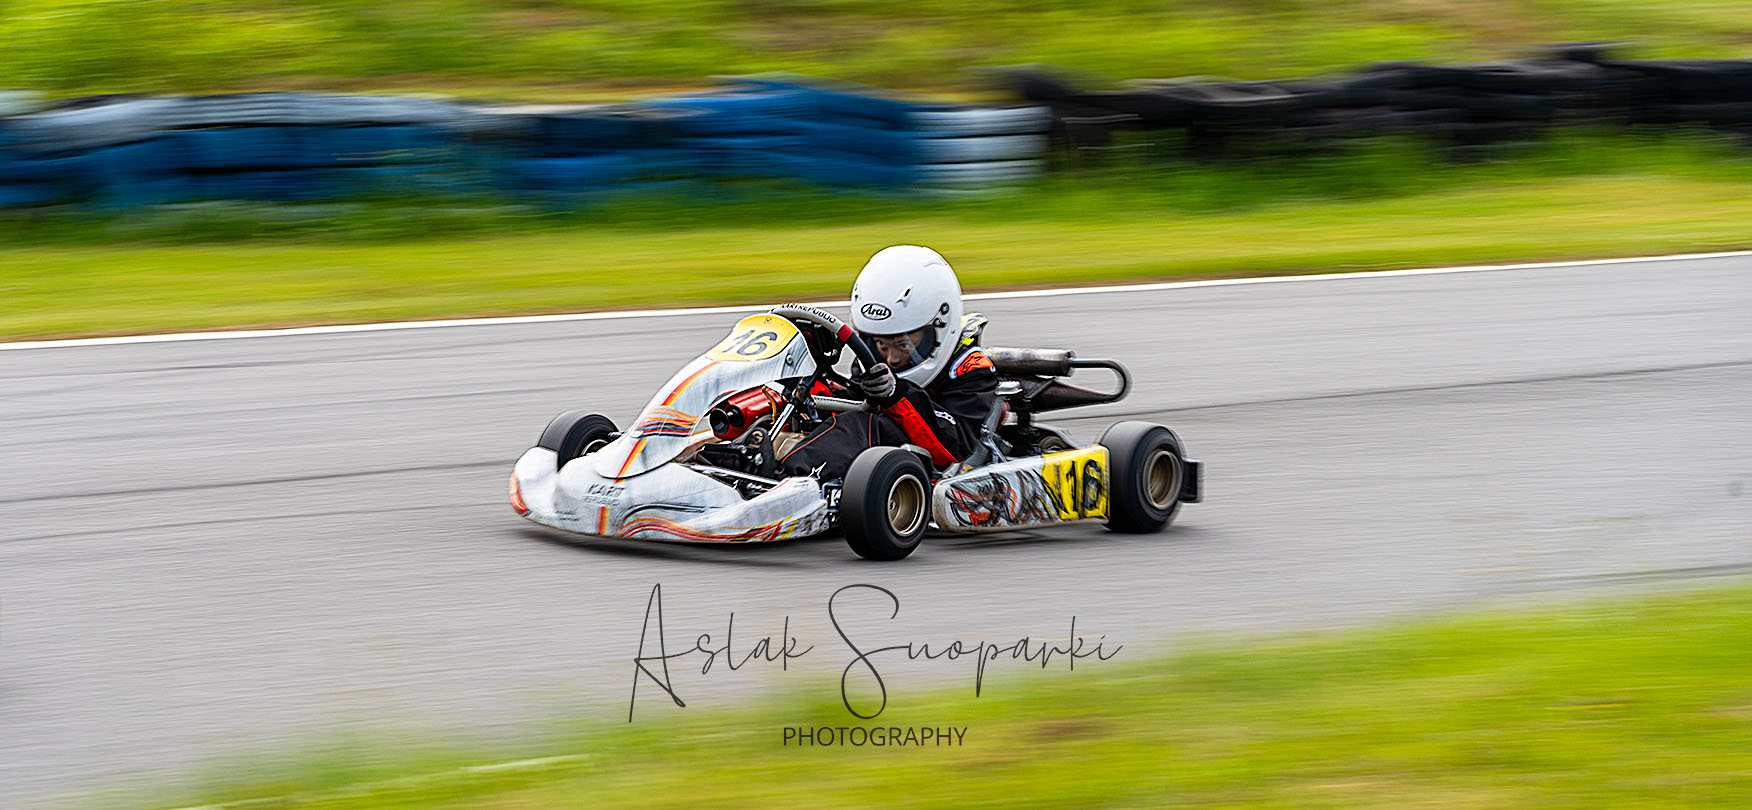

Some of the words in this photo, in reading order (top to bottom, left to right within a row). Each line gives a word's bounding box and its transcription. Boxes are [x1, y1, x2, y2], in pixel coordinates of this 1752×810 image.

[864, 304, 888, 317] Arai
[723, 329, 778, 355] 16
[1065, 458, 1104, 512] 16
